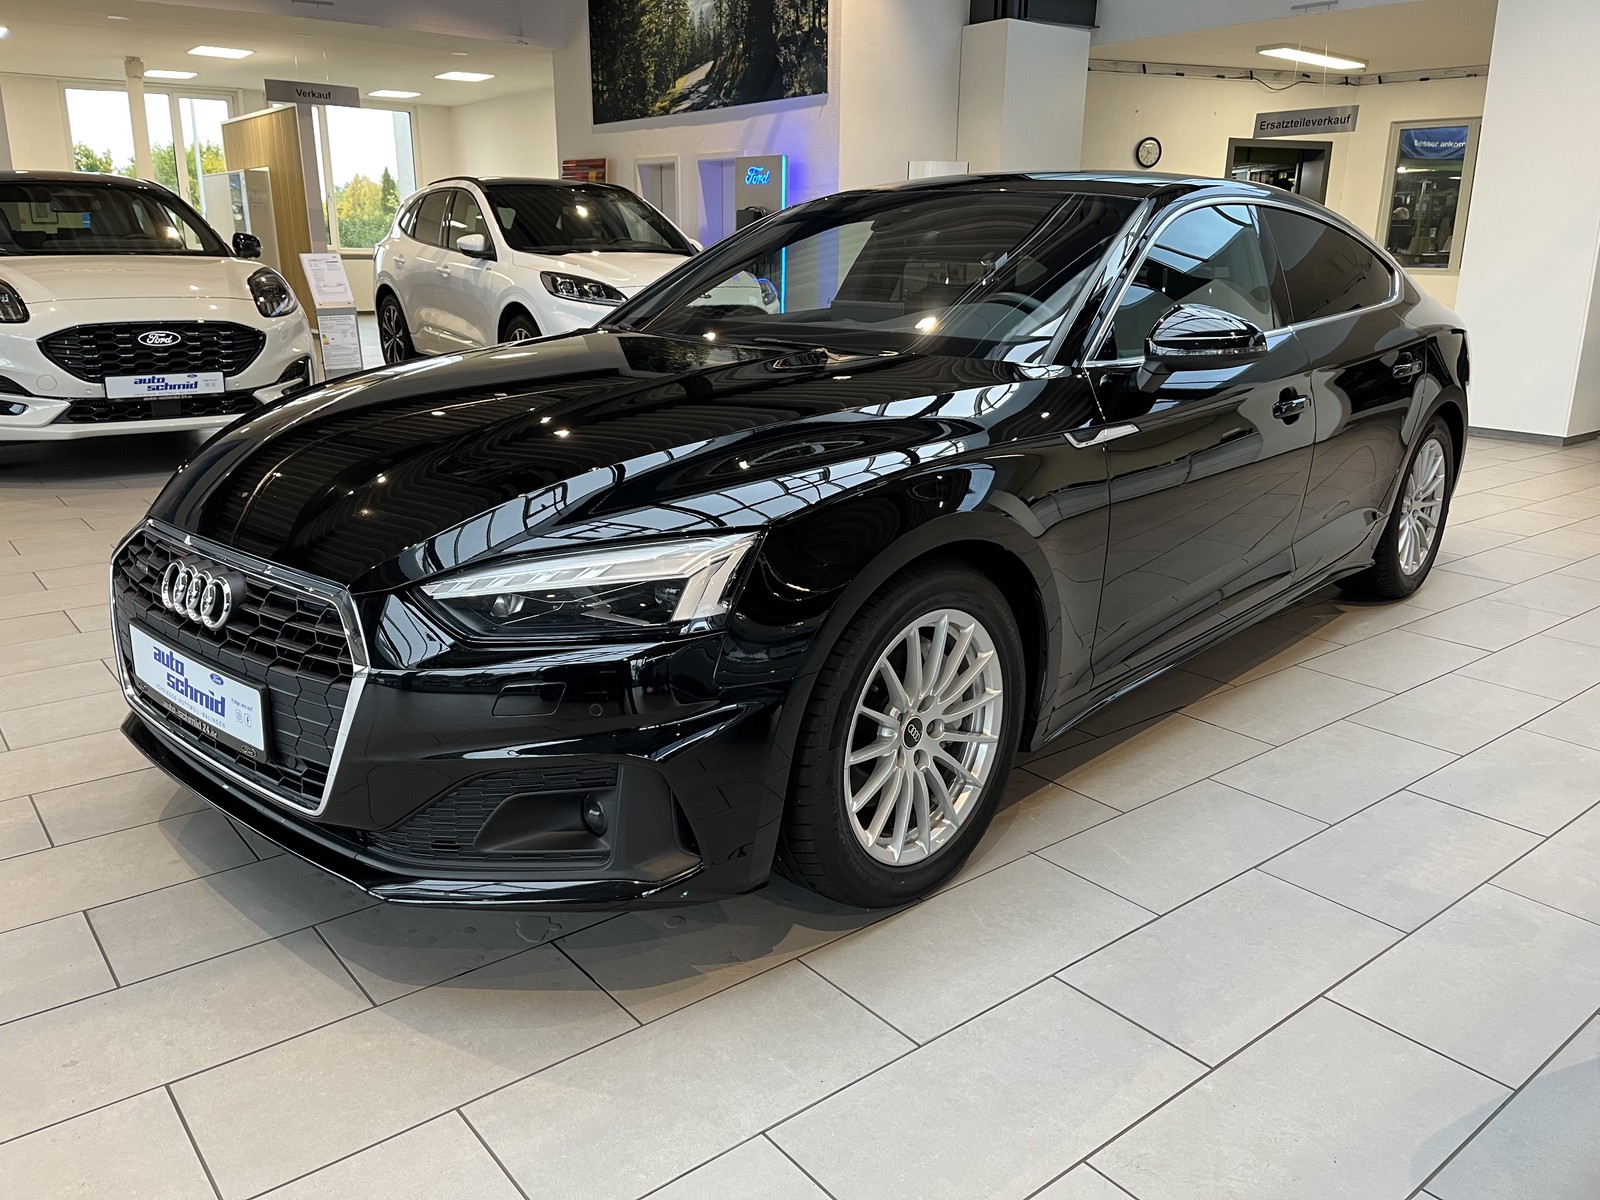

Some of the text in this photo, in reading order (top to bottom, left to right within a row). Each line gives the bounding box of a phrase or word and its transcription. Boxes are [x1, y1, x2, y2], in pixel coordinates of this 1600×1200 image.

[295, 88, 332, 100] Verkauf
[1259, 113, 1352, 131] Ersatzteileverkauf
[745, 166, 770, 185] Ford
[133, 375, 166, 385] auto
[147, 381, 198, 391] schmid
[153, 646, 185, 677] auto
[166, 672, 226, 718] schmid
